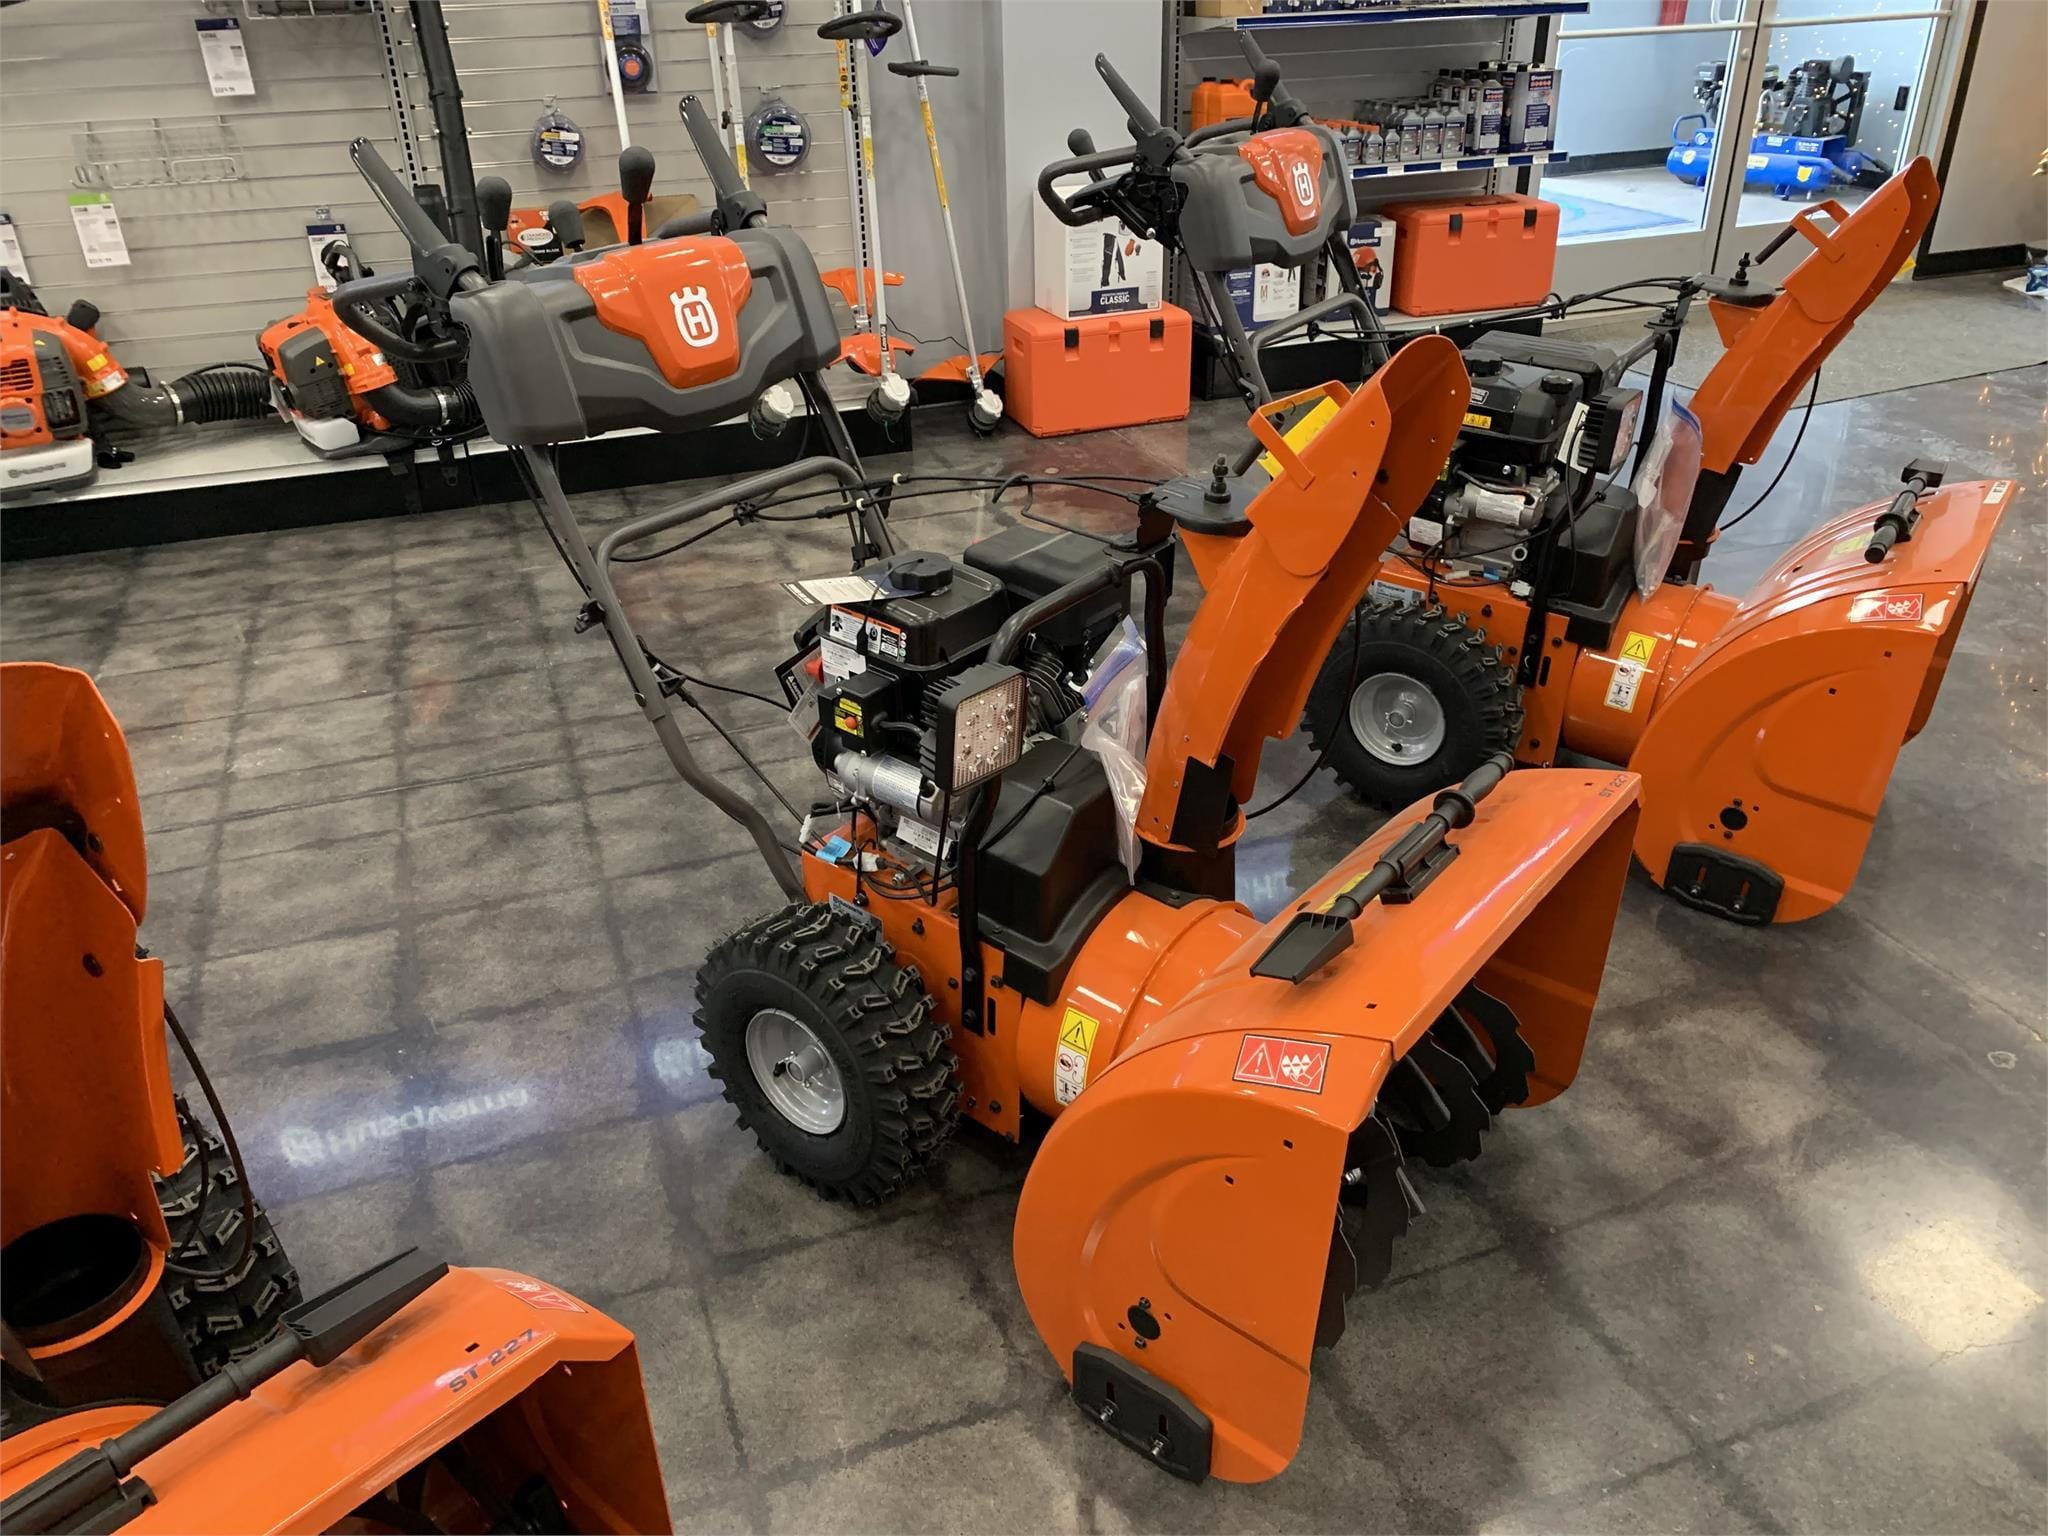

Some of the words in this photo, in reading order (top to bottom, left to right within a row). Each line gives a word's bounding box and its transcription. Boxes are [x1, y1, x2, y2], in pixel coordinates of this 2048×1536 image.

[1100, 293, 1130, 305] CLASSIC
[449, 1363, 479, 1392] ST
[488, 1328, 532, 1367] 227
